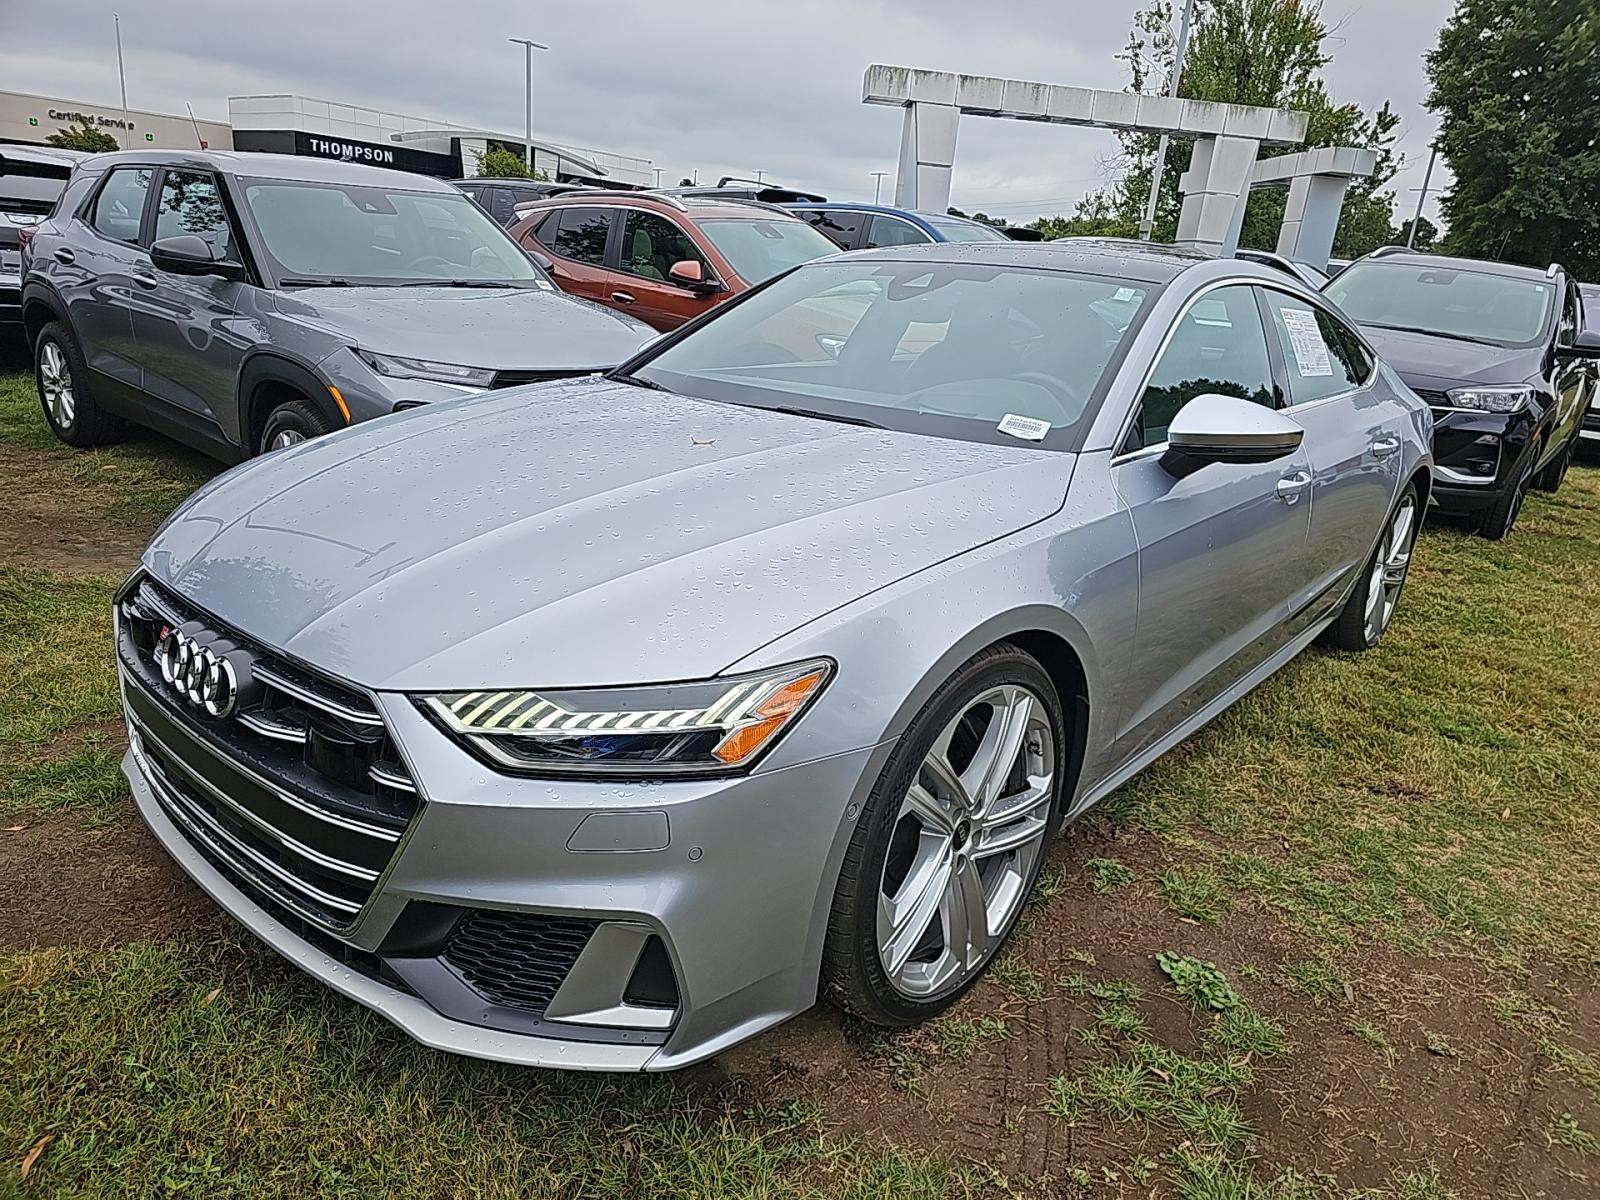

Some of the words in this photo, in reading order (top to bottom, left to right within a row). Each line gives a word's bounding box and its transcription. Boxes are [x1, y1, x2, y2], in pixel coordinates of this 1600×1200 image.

[48, 109, 95, 124] Certifed
[97, 116, 135, 130] Servie
[309, 139, 394, 163] THOMPSON
